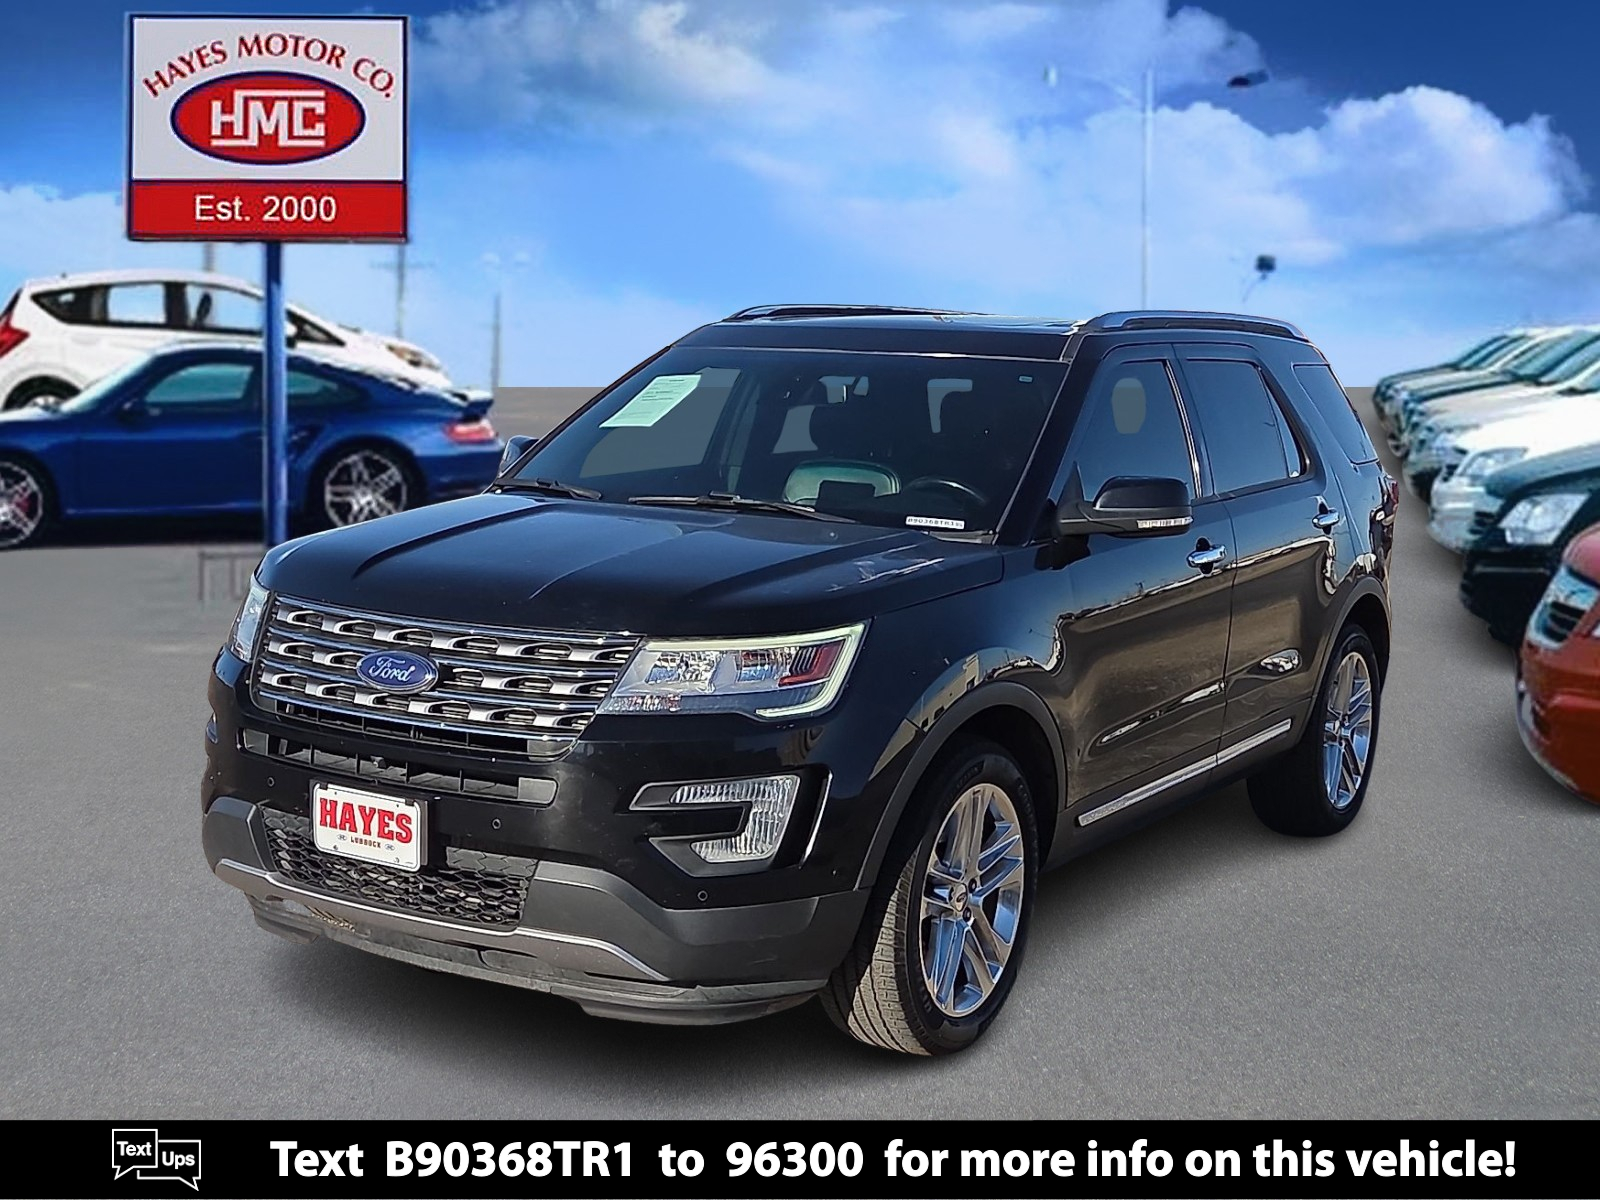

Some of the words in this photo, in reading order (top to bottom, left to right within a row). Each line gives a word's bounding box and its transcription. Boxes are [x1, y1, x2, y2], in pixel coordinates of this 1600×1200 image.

[142, 40, 228, 97] HAYES
[237, 33, 347, 70] MOTOR
[352, 58, 394, 98] CO.
[210, 89, 326, 147] HMC
[194, 195, 250, 221] Est.
[262, 195, 337, 222] 2000
[368, 656, 416, 682] Ford
[319, 797, 413, 844] HAYES
[350, 836, 382, 849] LUBBOCK
